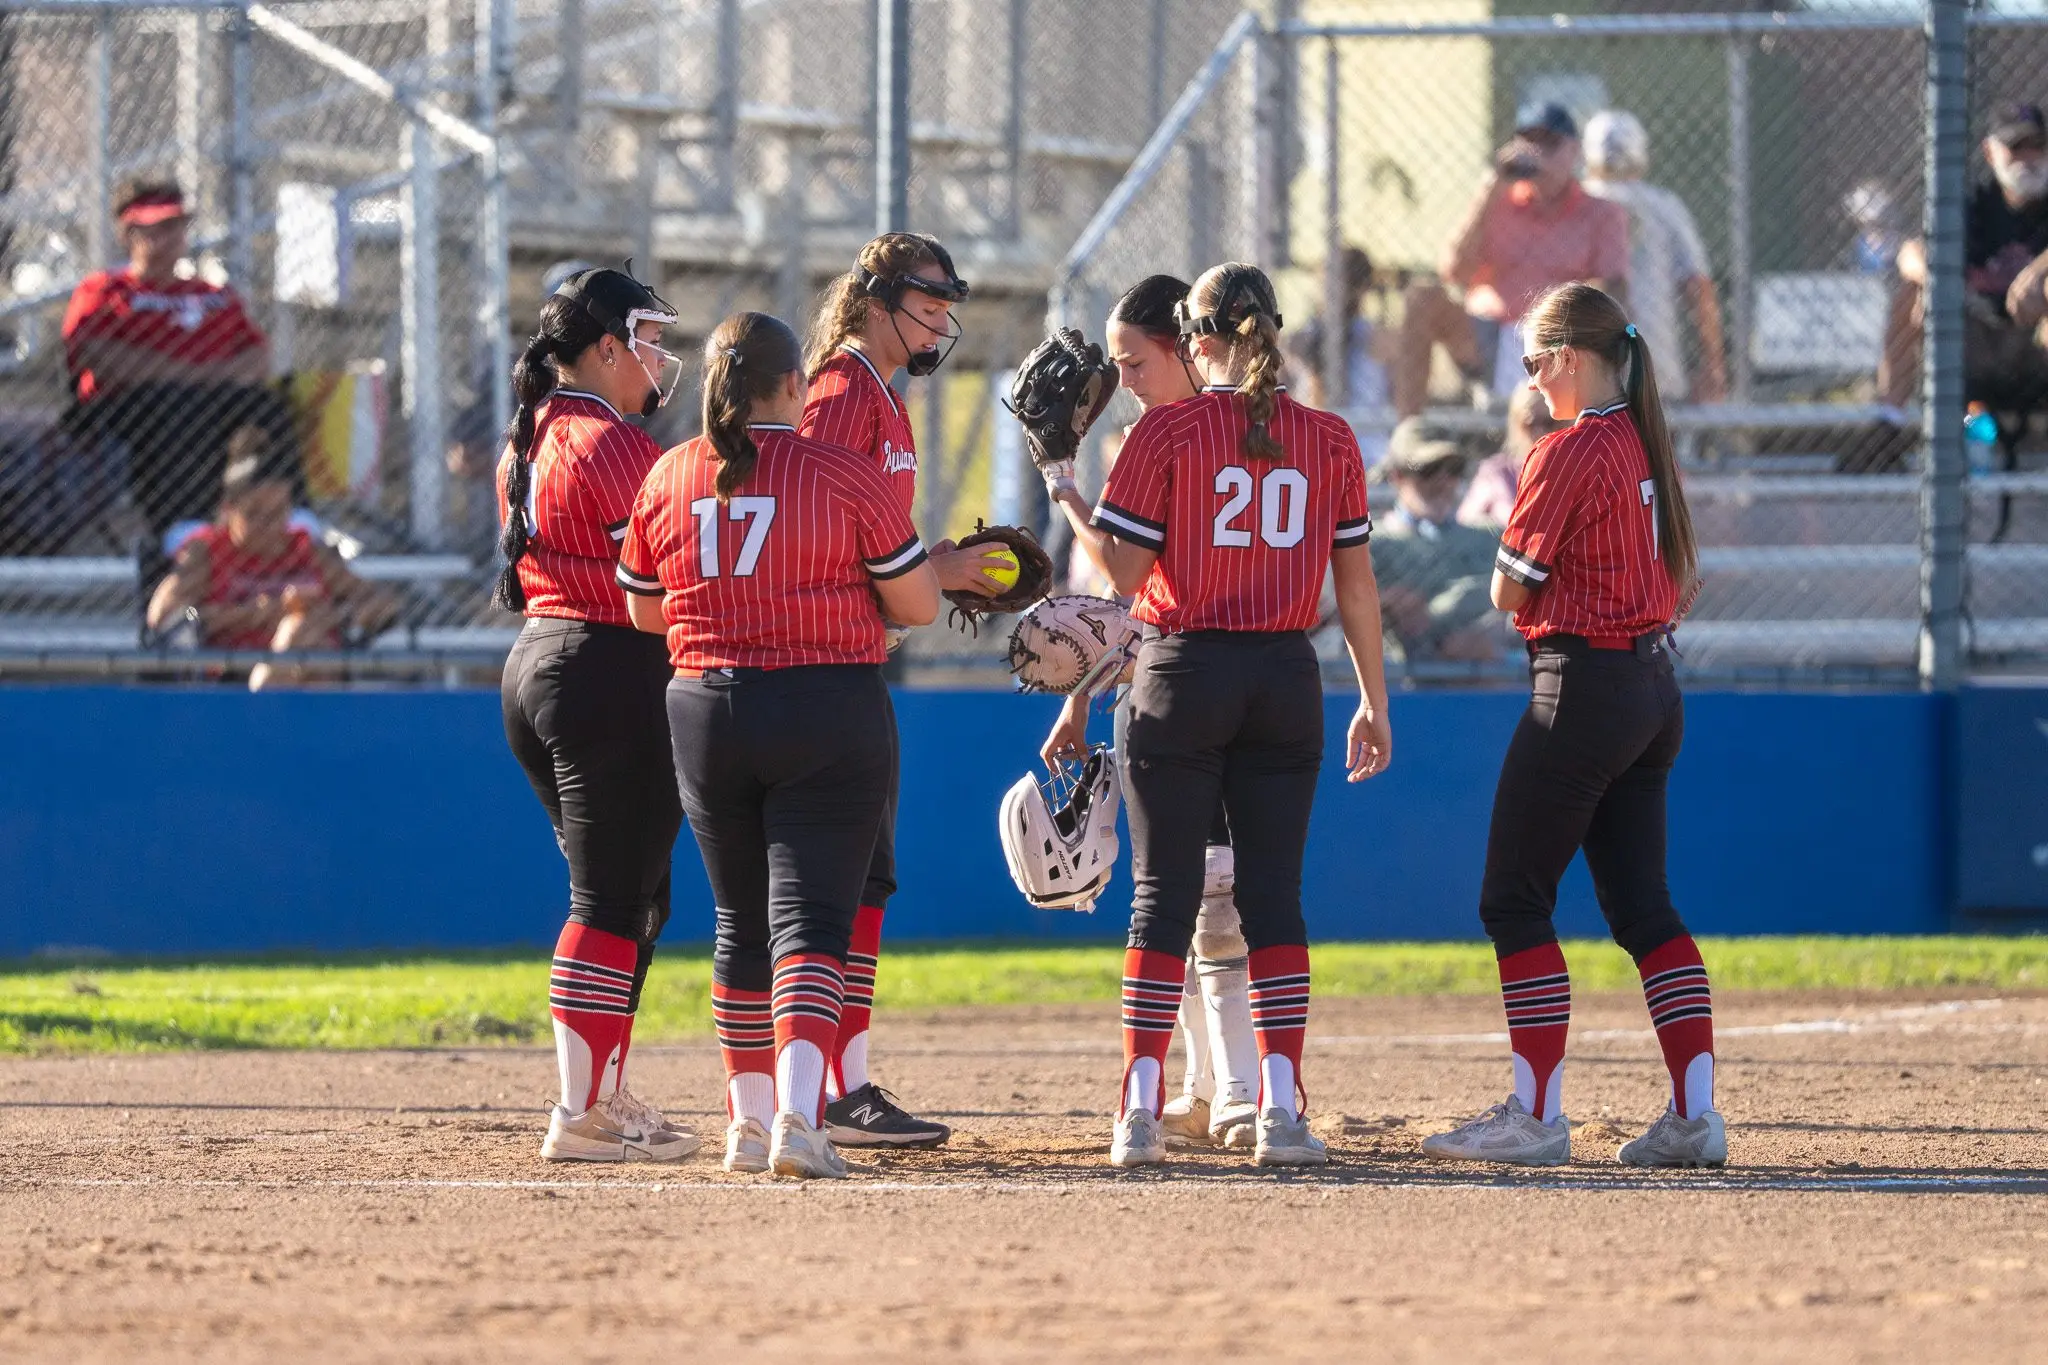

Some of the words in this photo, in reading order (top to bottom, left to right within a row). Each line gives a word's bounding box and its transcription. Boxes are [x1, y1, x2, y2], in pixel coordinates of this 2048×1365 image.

[691, 496, 777, 578] 17
[1212, 464, 1309, 549] 20
[1057, 850, 1073, 880] EASTON
